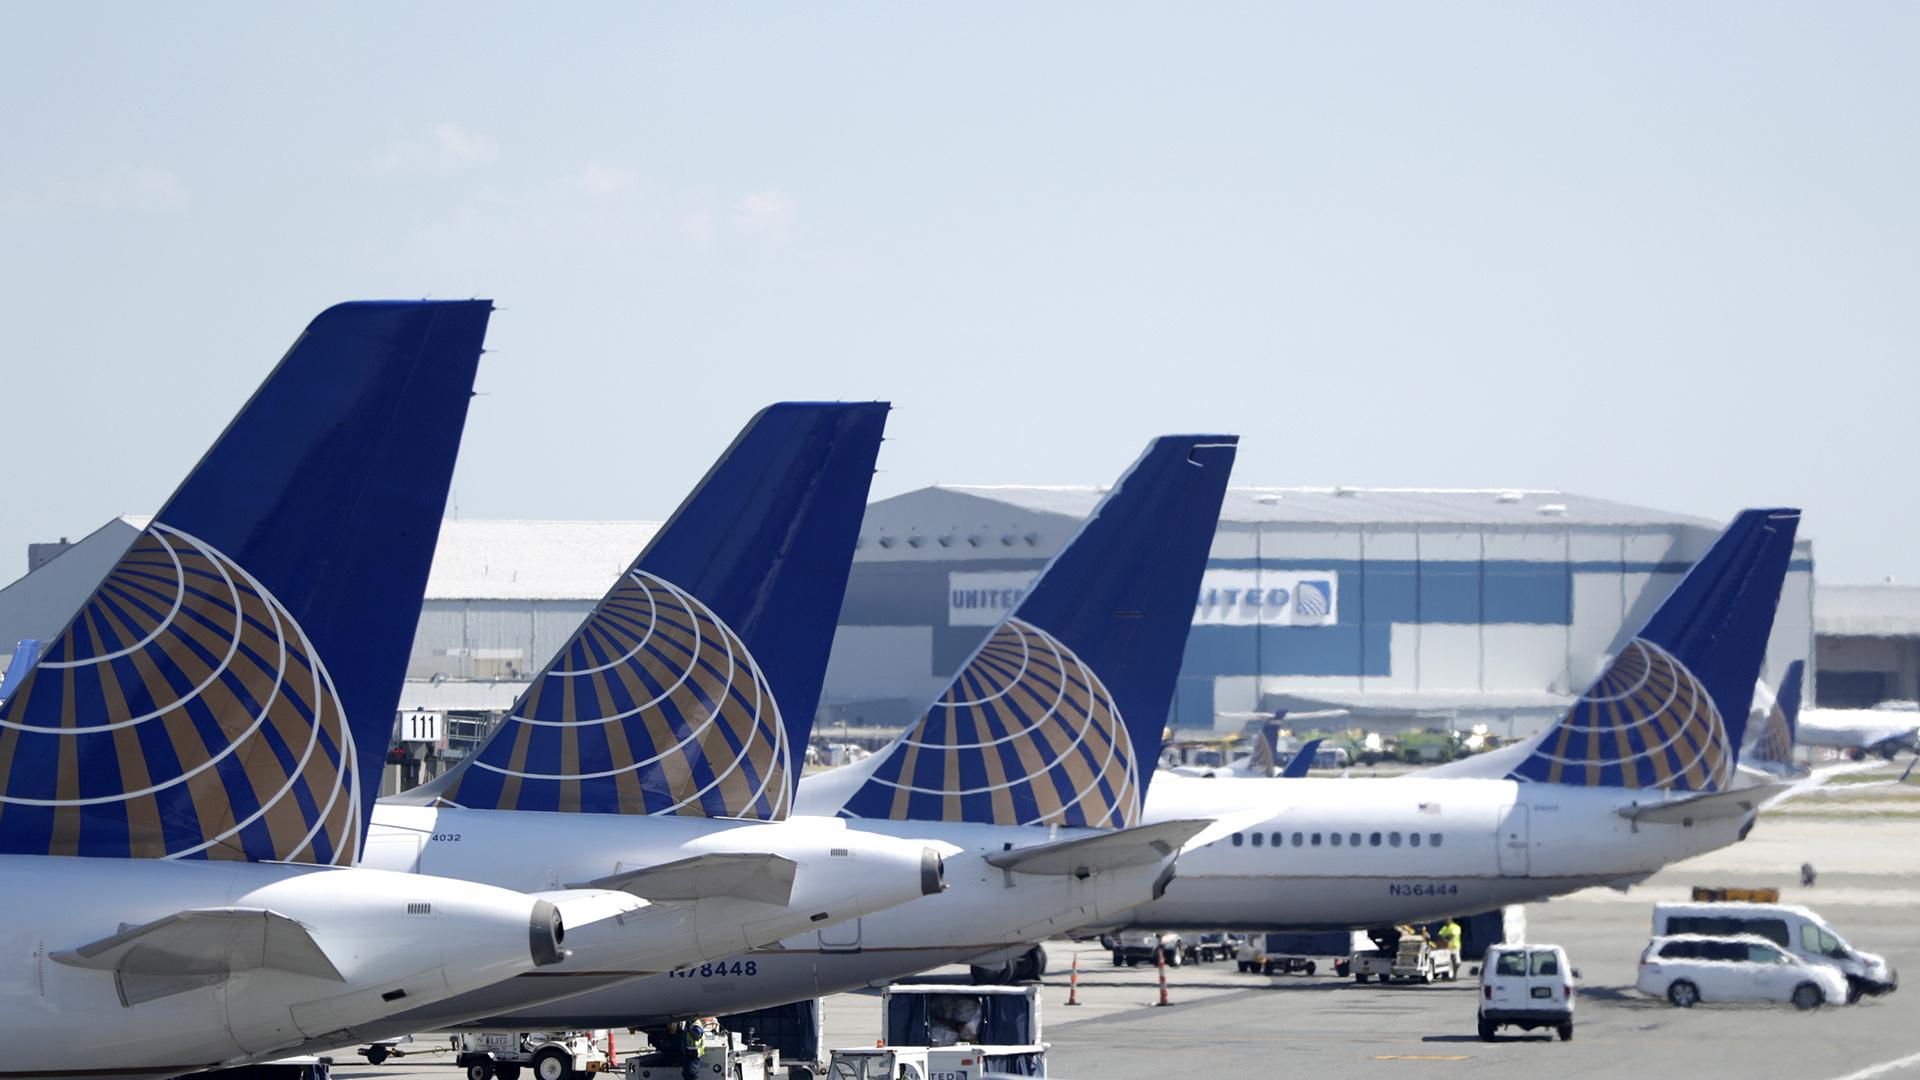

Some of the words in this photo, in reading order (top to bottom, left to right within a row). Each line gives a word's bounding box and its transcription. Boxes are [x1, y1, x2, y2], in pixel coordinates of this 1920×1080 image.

[1199, 588, 1290, 606] ITED
[411, 715, 434, 738] 111
[1390, 884, 1458, 896] N36444
